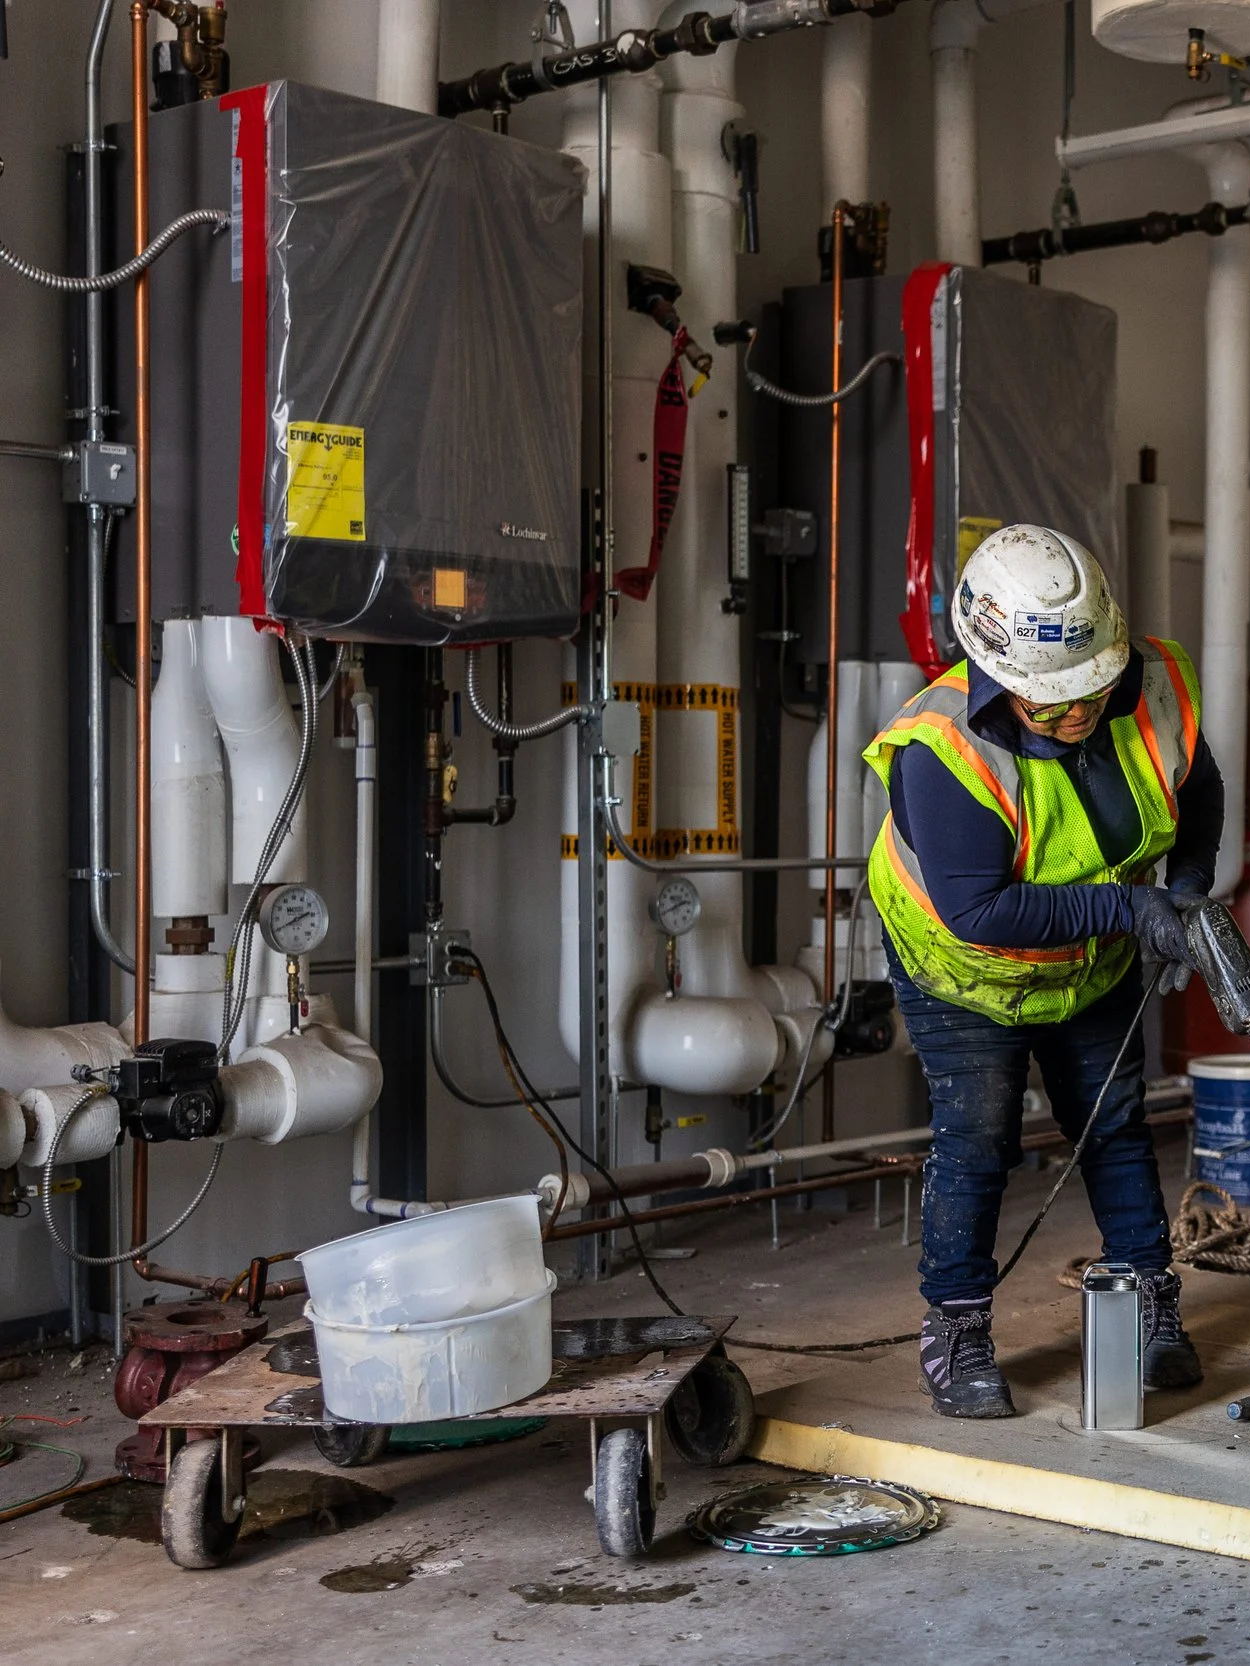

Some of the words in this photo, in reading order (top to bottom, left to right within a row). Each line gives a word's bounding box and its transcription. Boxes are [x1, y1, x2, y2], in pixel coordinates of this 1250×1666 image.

[512, 525, 547, 541] Lochinvar
[1016, 627, 1036, 638] 627
[640, 715, 650, 737] HOT
[722, 712, 734, 735] HOT
[638, 741, 650, 780] WATER
[722, 739, 734, 778] WATER
[637, 783, 650, 828] RETURN
[722, 781, 735, 825] SUPPLY
